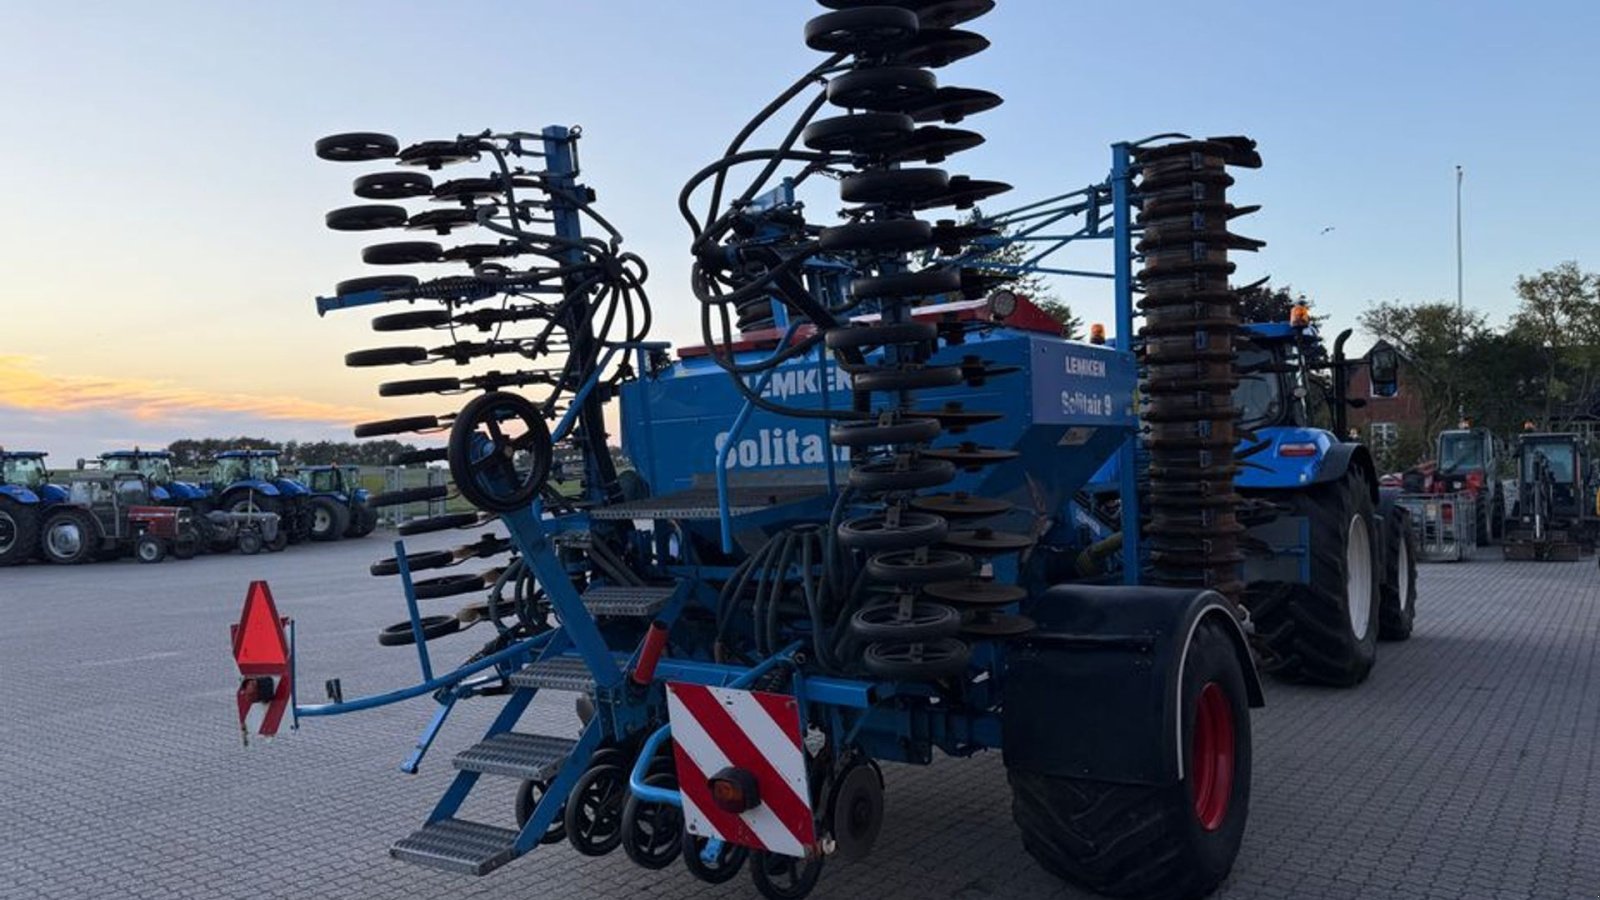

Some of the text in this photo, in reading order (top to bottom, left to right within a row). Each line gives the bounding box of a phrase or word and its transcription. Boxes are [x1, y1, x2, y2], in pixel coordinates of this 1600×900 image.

[1065, 355, 1106, 377] LEMKEN
[1061, 390, 1112, 416] Solitair 9
